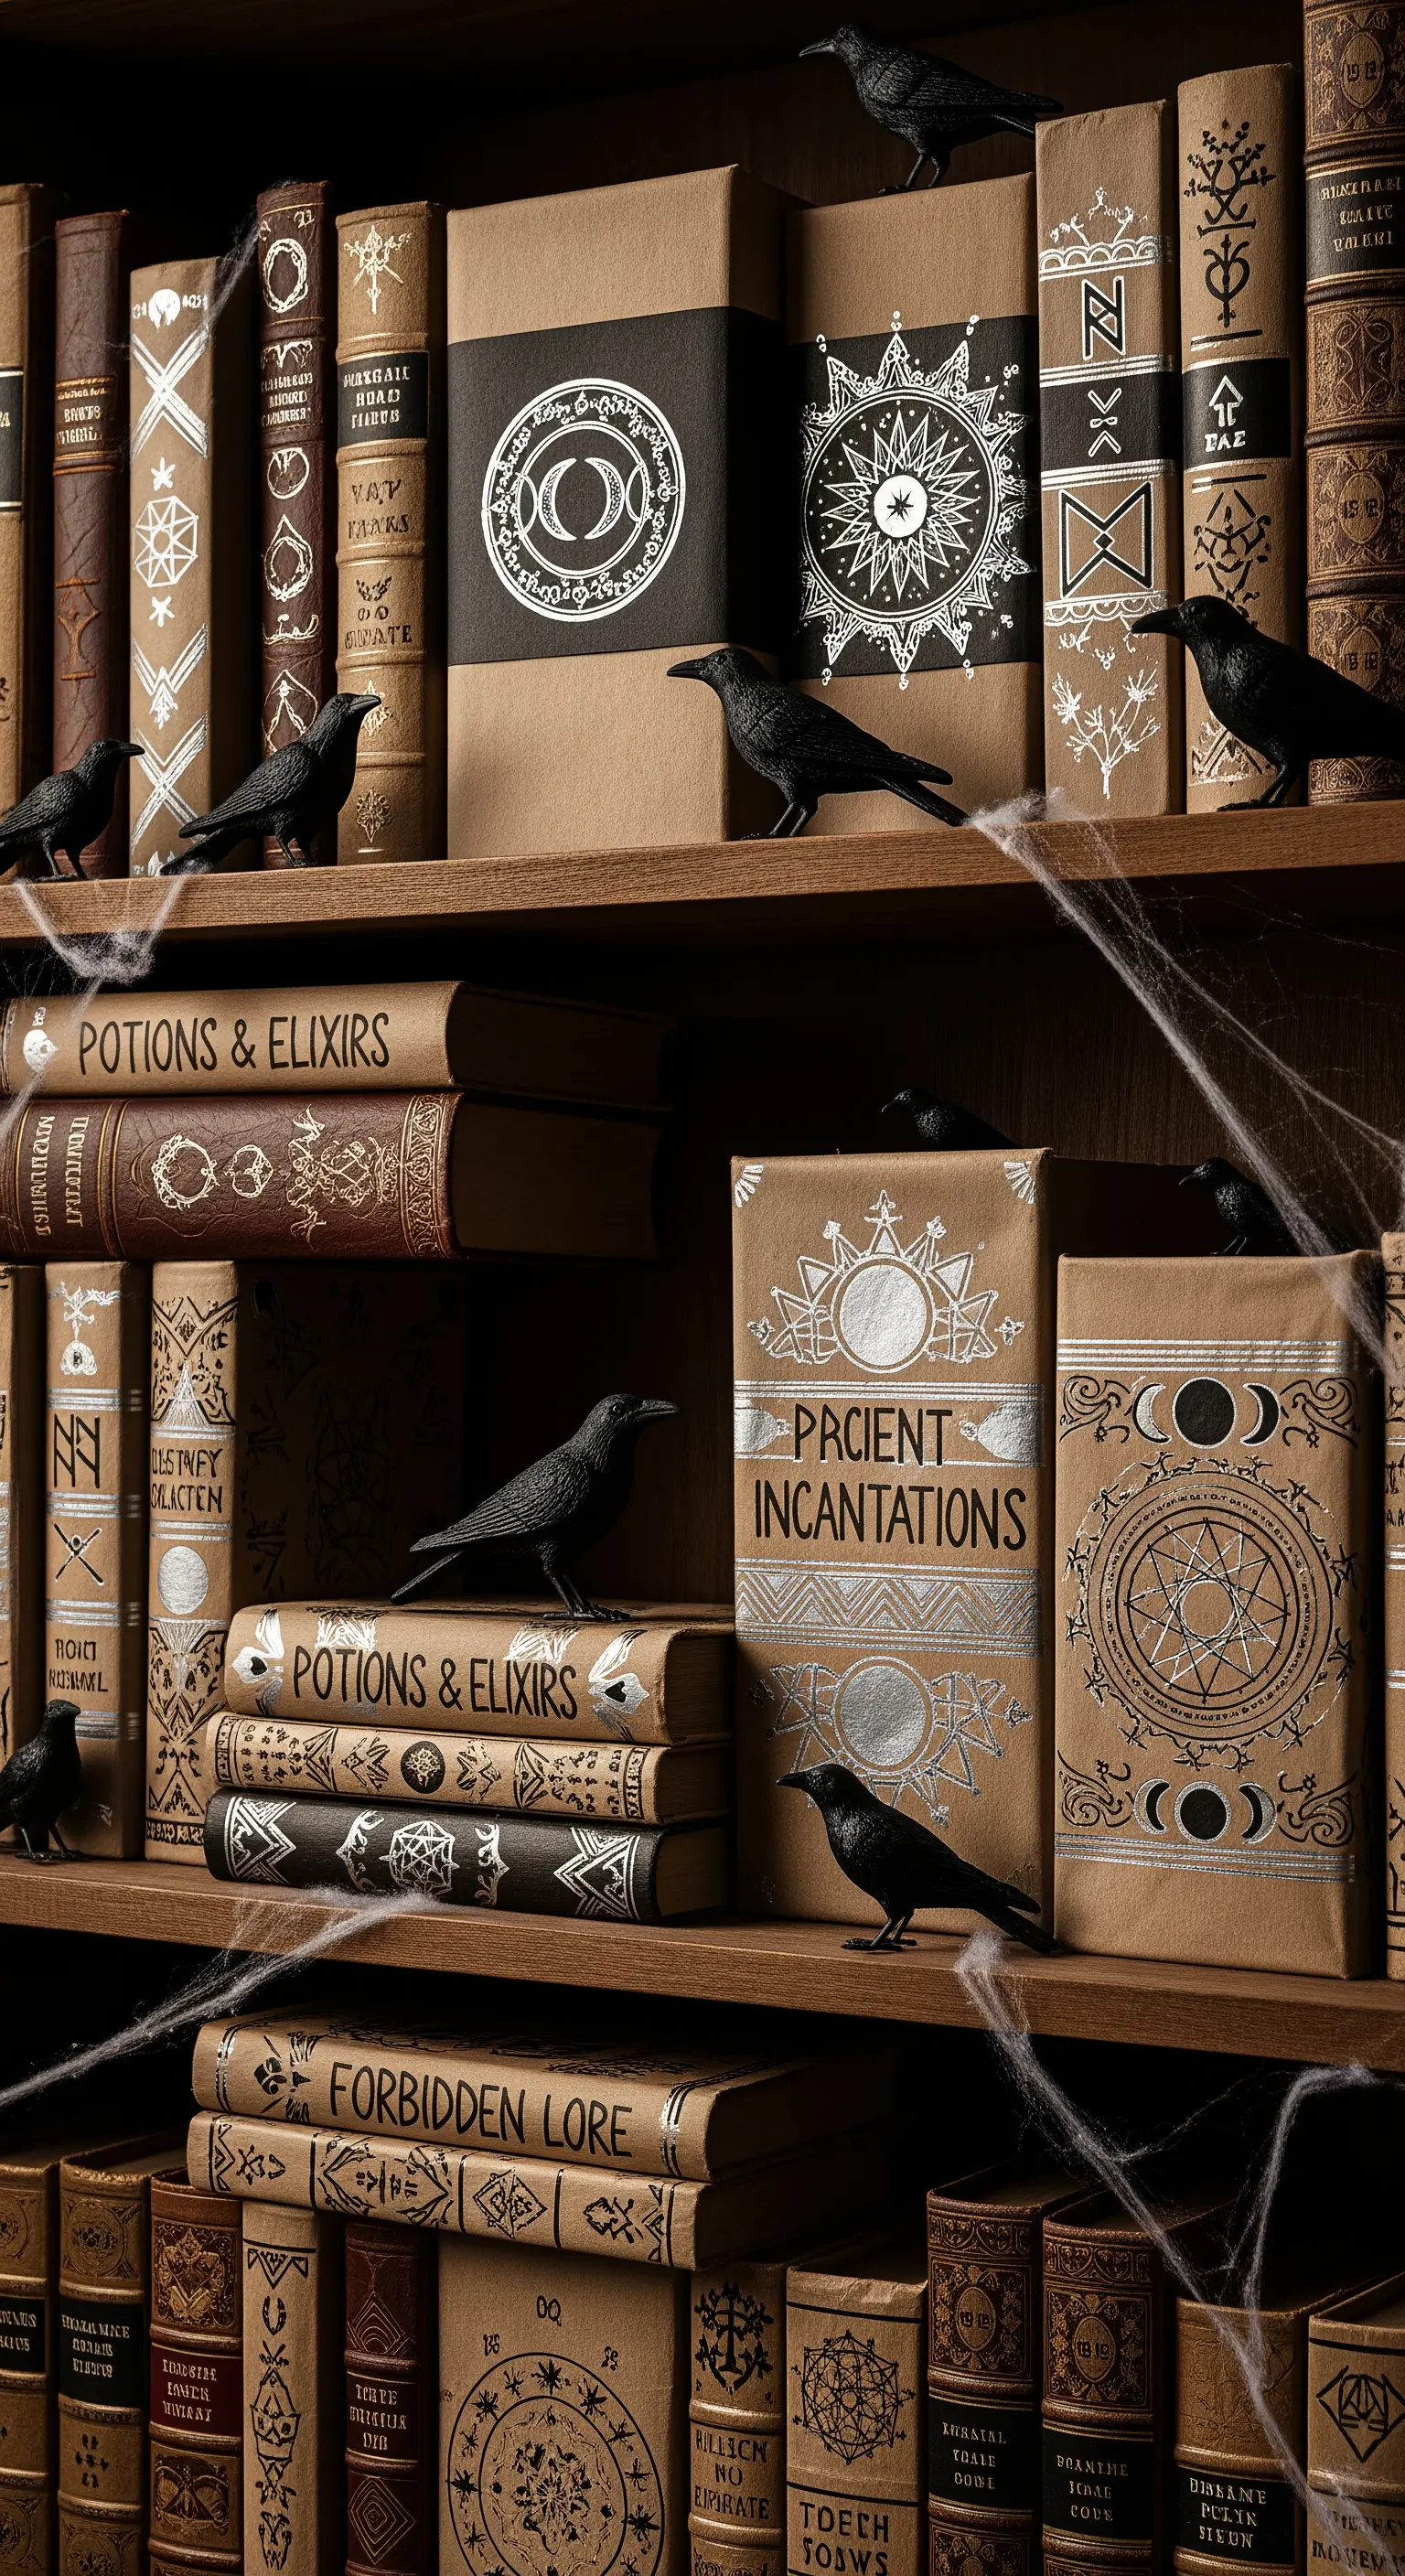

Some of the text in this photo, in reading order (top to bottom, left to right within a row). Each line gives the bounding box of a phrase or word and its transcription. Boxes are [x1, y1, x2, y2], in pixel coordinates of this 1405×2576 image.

[79, 1011, 390, 1075] POTIONS & ELIXIRS
[755, 1478, 1027, 1551] INCANTATIONS
[293, 1645, 579, 1722] POTIONS & ELIXIRS
[329, 2061, 634, 2159] FORBIDDEN LORE
[715, 2462, 744, 2486] NO
